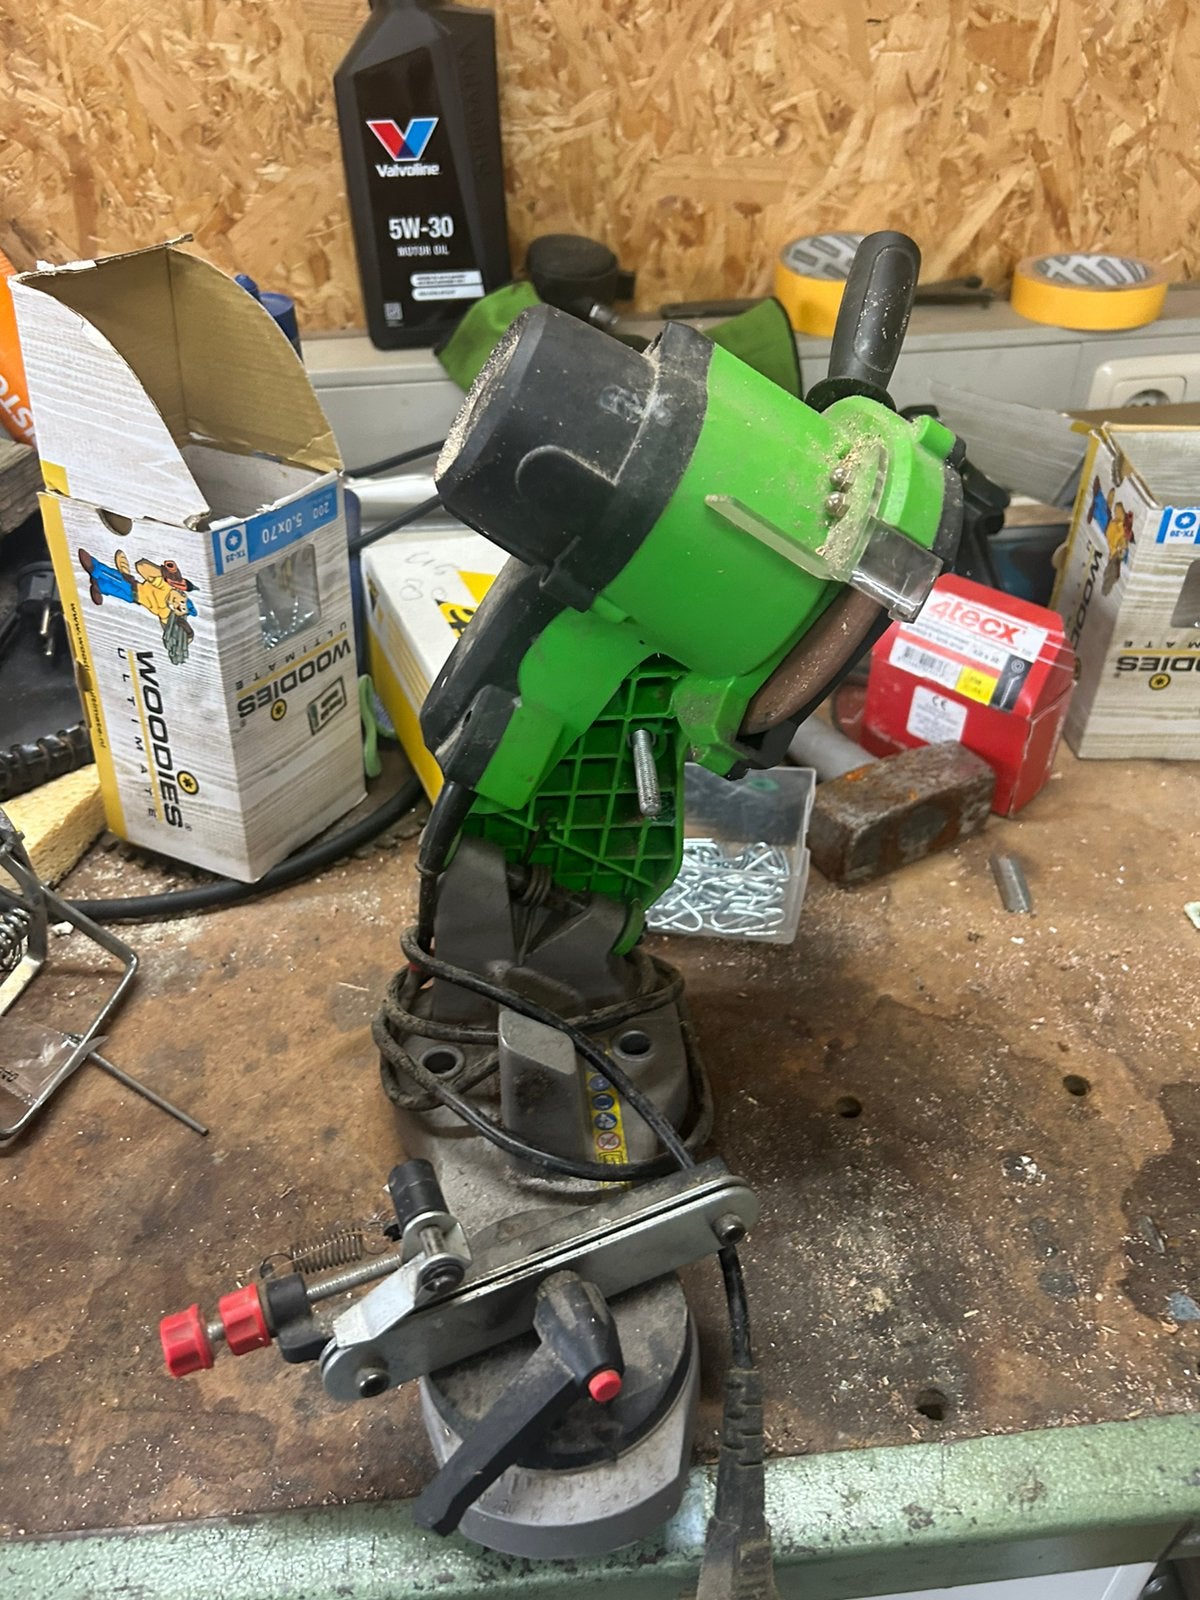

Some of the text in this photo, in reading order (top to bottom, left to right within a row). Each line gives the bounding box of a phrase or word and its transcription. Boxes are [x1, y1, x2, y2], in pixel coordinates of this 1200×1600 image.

[375, 163, 441, 178] Valvoline
[388, 215, 454, 240] 5W-30
[397, 244, 450, 257] MOTOR OIL
[262, 512, 303, 544] 5.0x70
[929, 599, 1018, 645] 4tecx
[1070, 549, 1103, 652] WOOD
[235, 621, 347, 691] ULTIMATE
[1115, 656, 1200, 672] DIES
[1123, 640, 1200, 649] MATE
[70, 603, 106, 749] www.woodiultimate.nl
[237, 639, 351, 718] WOODIES
[118, 648, 157, 818] ULTIMATE
[136, 651, 183, 828] WOODIES
